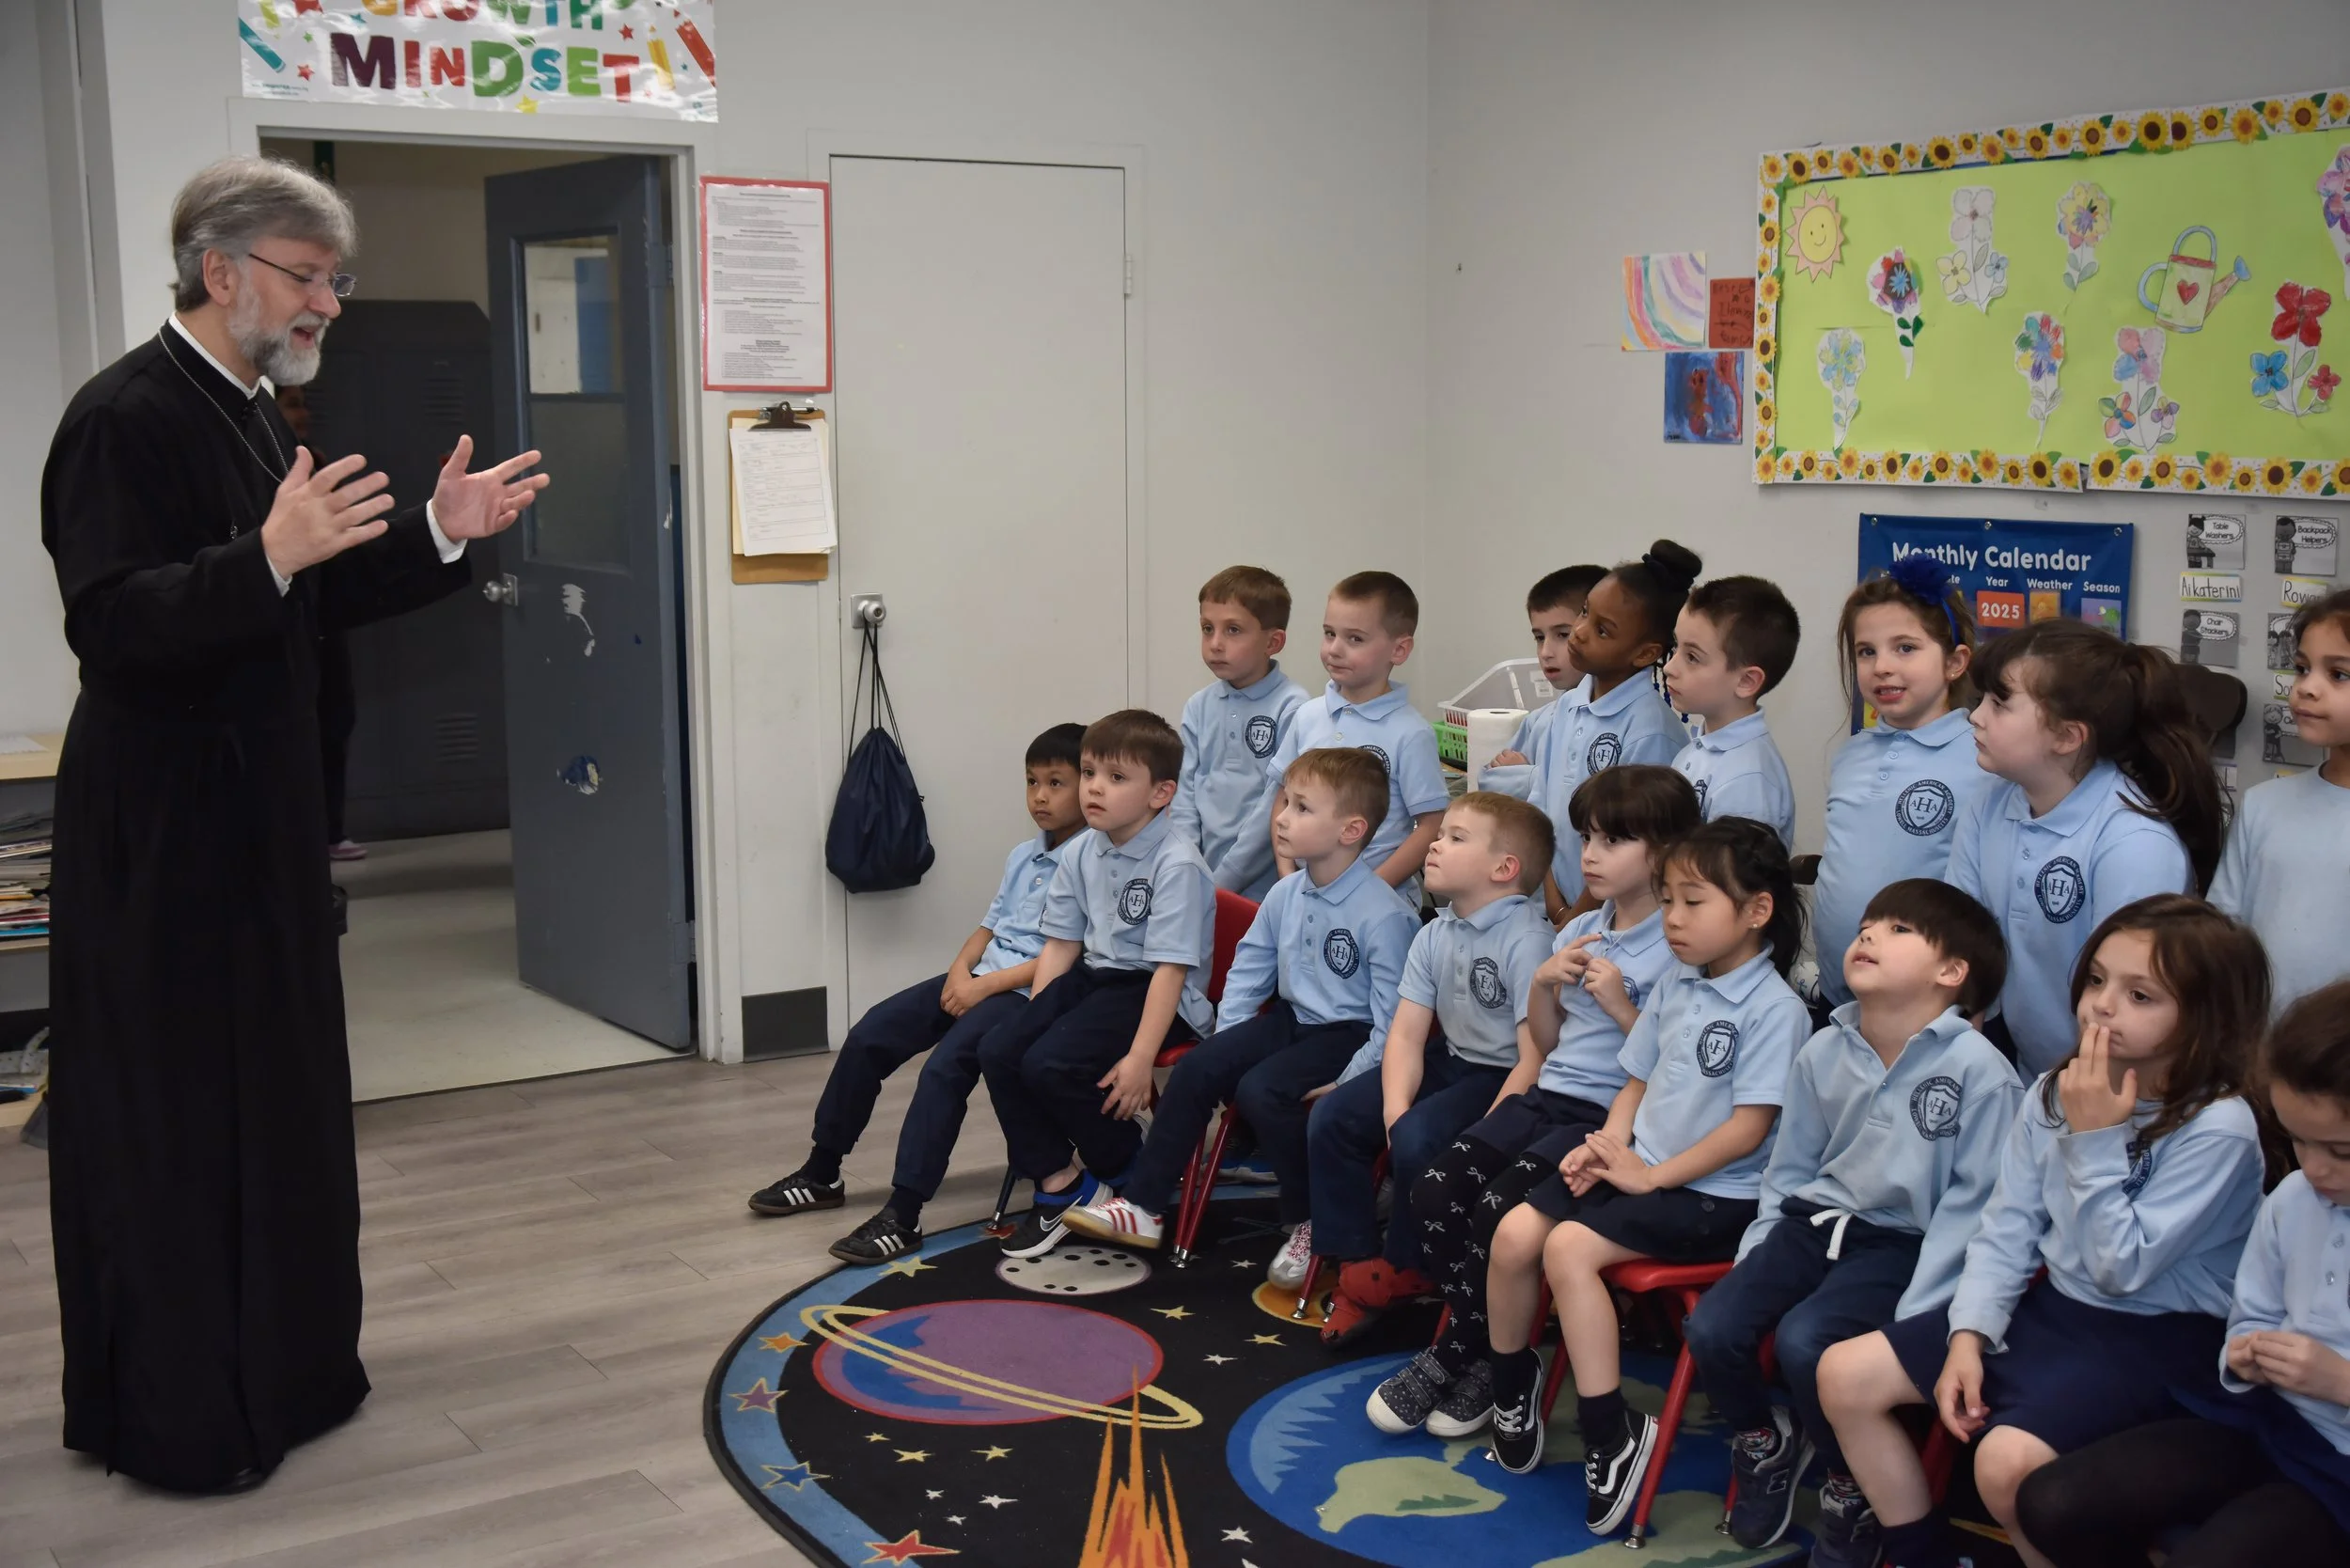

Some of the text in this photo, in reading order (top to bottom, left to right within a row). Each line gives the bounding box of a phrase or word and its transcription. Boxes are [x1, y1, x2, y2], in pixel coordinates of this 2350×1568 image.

[330, 32, 640, 102] MINDSET
[2212, 522, 2230, 530] Table
[2297, 525, 2332, 535] Backpack
[2205, 531, 2234, 540] Washers
[2301, 535, 2327, 544] Helpers
[1984, 545, 2092, 572] Calendar
[1985, 575, 2122, 593] Year Weather Season
[2181, 576, 2240, 599] Aikaterini
[1981, 602, 2020, 619] 2025
